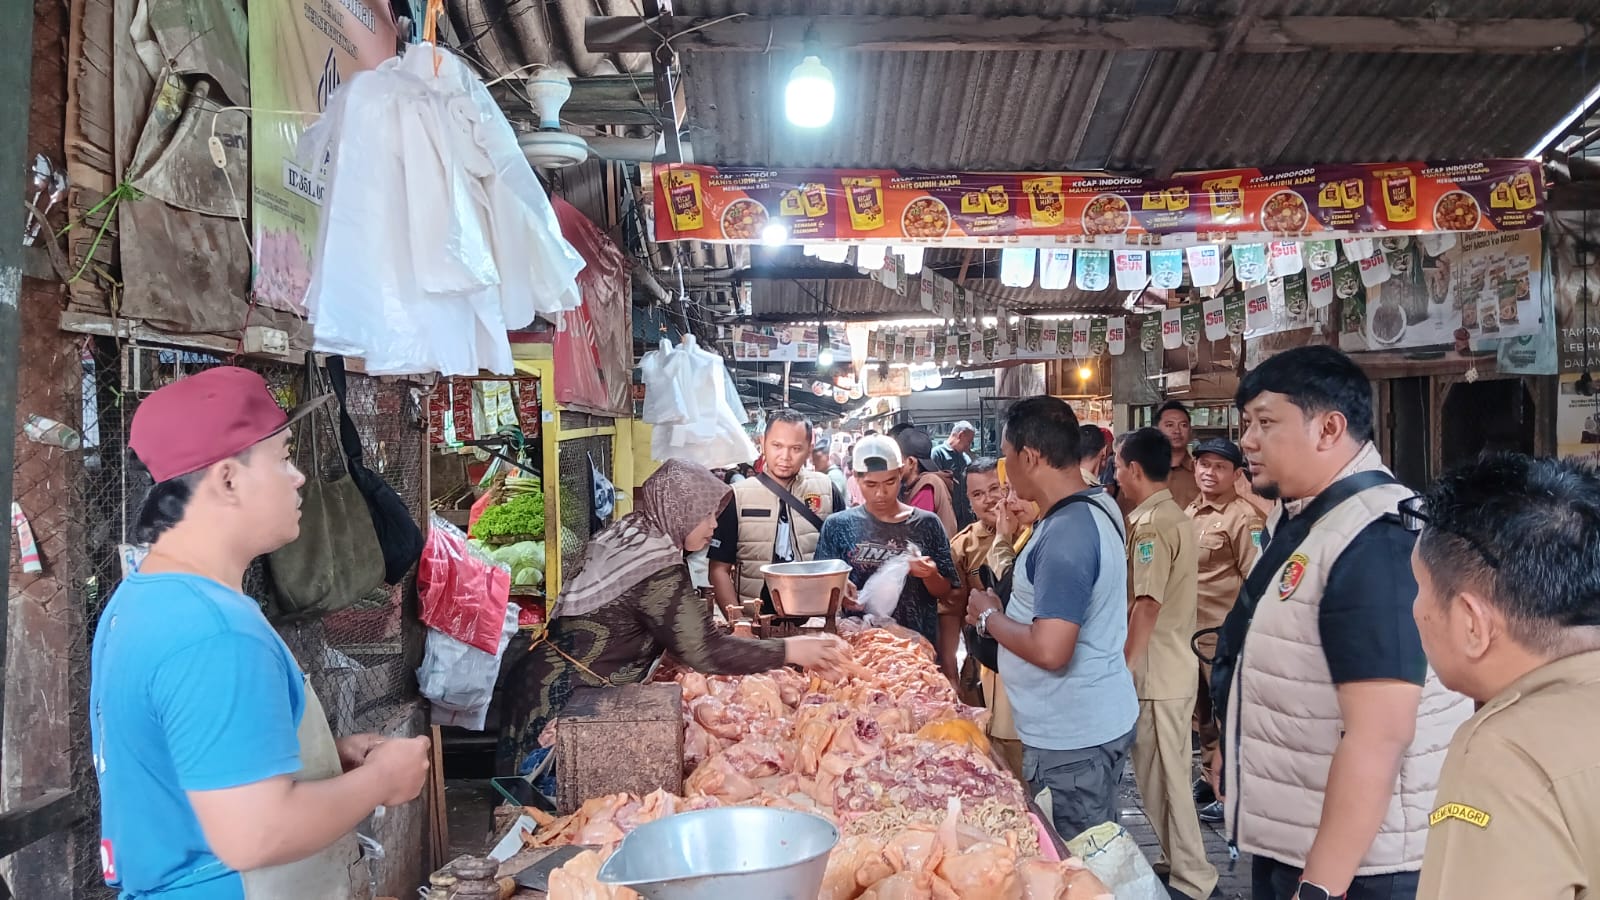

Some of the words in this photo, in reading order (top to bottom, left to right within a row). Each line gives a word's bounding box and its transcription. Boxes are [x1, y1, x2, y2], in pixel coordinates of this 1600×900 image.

[1275, 168, 1315, 180] INDOFOOD
[1072, 180, 1097, 188] KECAP
[1099, 178, 1142, 186] INDOFOOD
[1270, 241, 1297, 259] SUN
[1116, 254, 1142, 271] SUN
[1190, 251, 1216, 267] SUN
[1360, 254, 1385, 271] SUN
[1311, 274, 1331, 292] SUN
[1248, 299, 1268, 314] SUN
[1206, 312, 1224, 326] SUN
[1163, 321, 1180, 335] SUN
[1432, 804, 1486, 824] KEMENDAGRI
